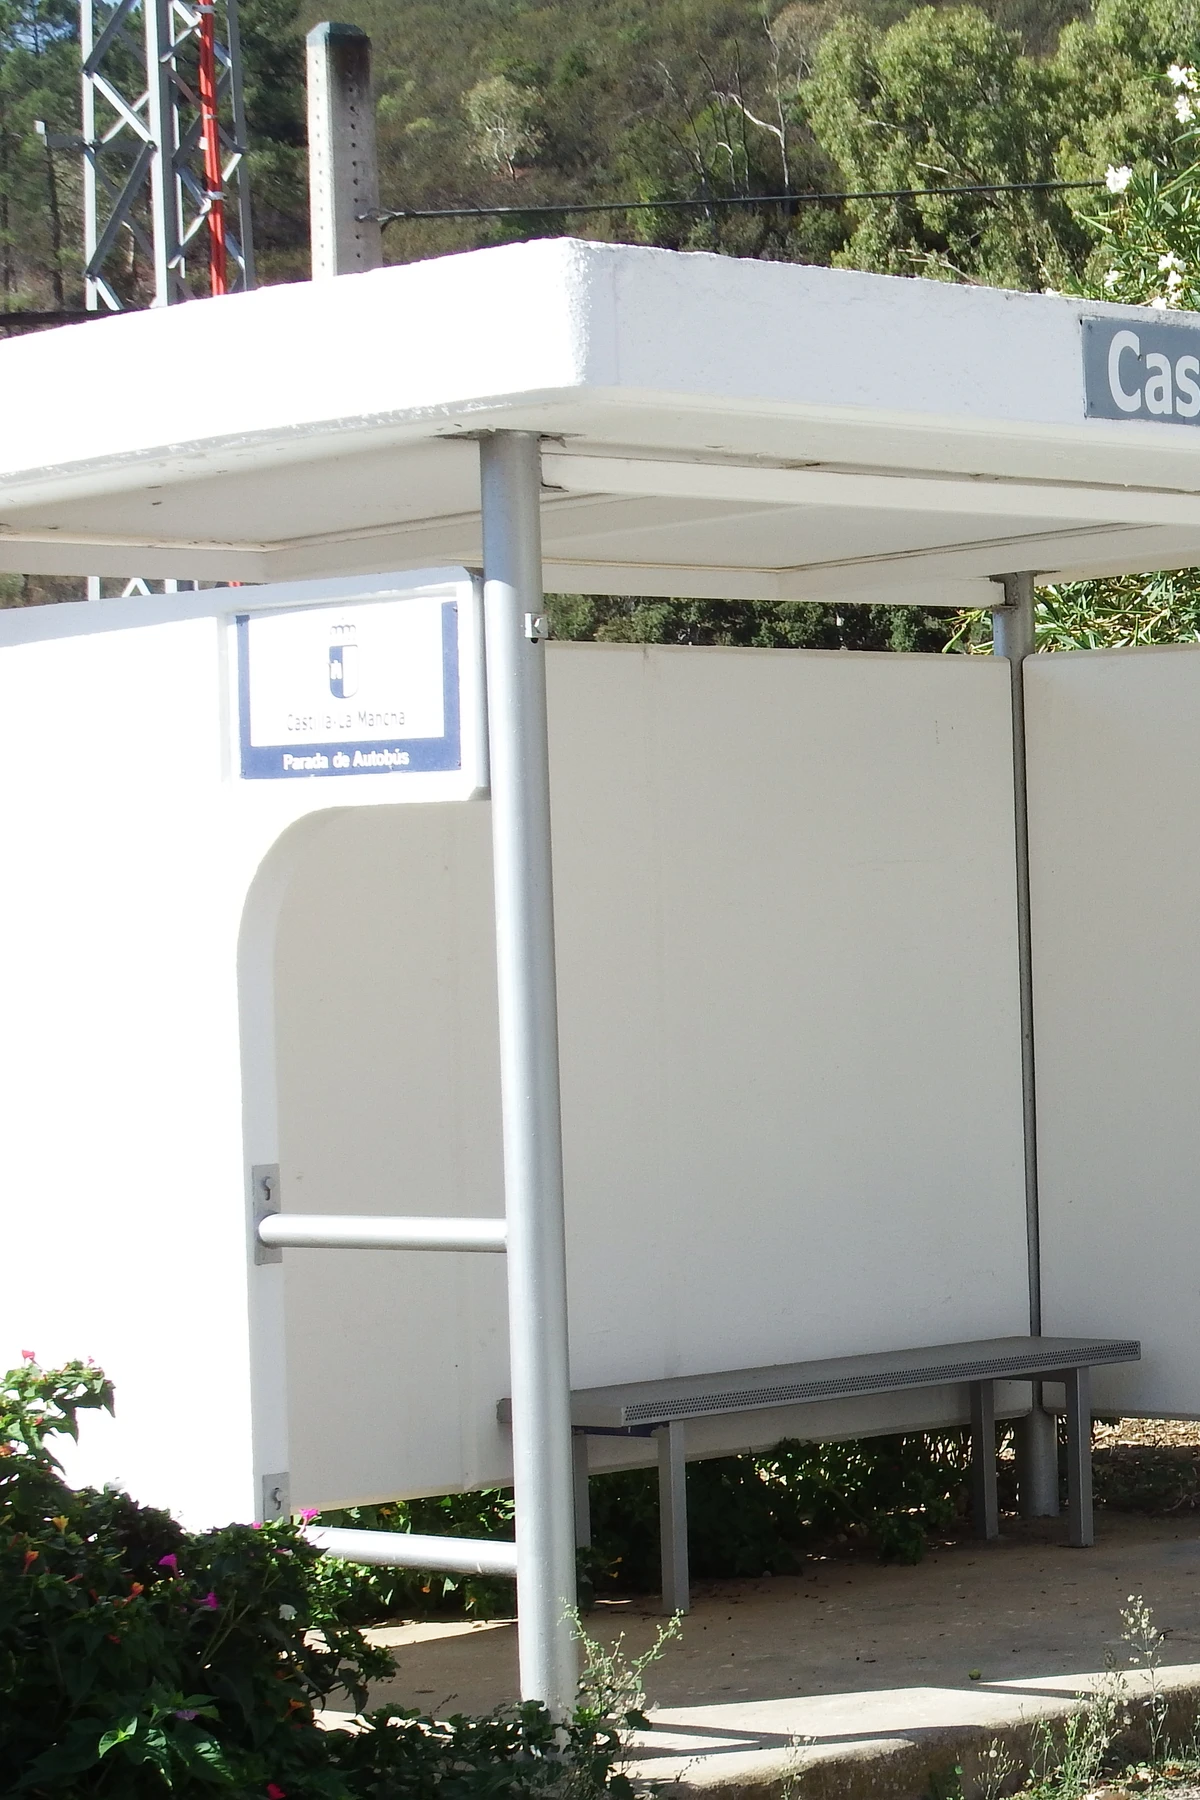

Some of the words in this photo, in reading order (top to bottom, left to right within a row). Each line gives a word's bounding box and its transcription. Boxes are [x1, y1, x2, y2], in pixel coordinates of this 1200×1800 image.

[283, 753, 328, 770] Parada
[333, 752, 350, 768] de
[353, 748, 410, 767] Autobús
